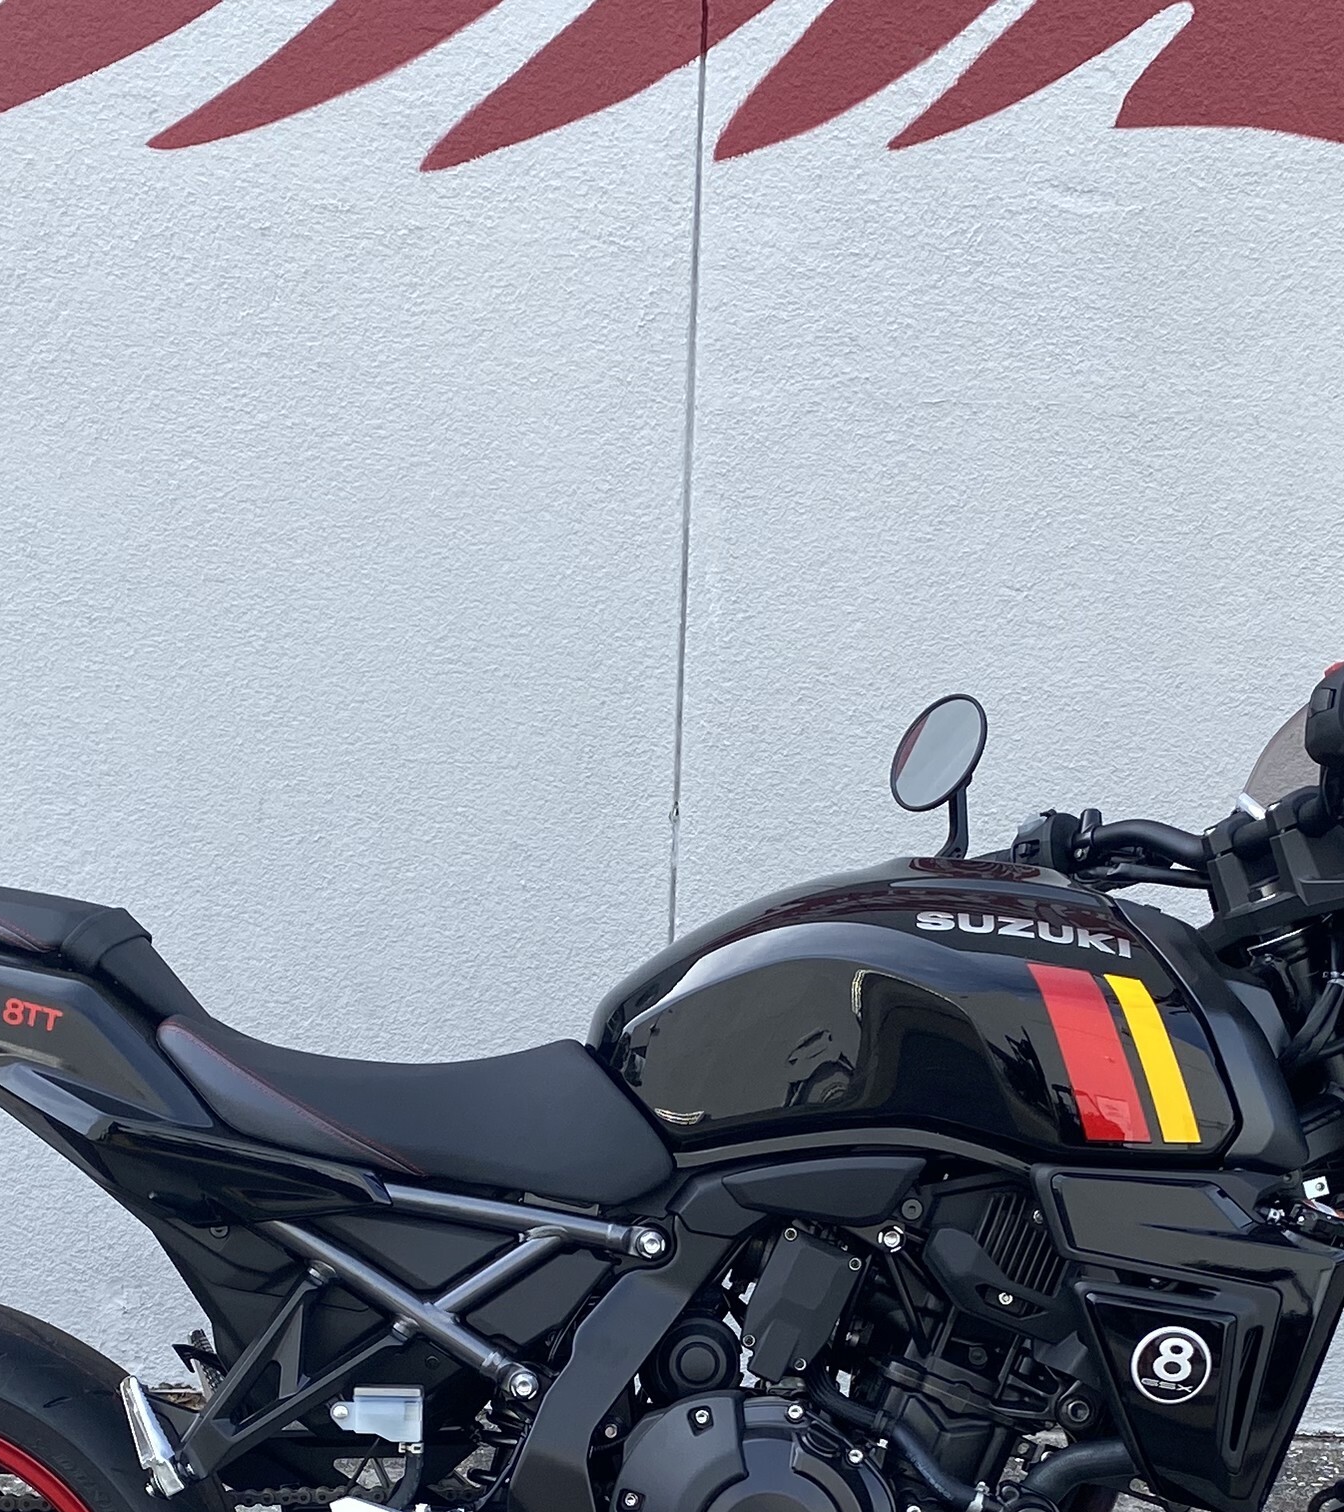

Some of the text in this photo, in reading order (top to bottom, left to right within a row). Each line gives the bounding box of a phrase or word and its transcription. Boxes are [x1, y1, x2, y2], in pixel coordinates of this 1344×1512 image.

[915, 911, 1132, 959] SUZUKI
[1, 997, 63, 1032] 8TT
[1153, 1338, 1194, 1382] 8
[1141, 1378, 1193, 1393] GSX
